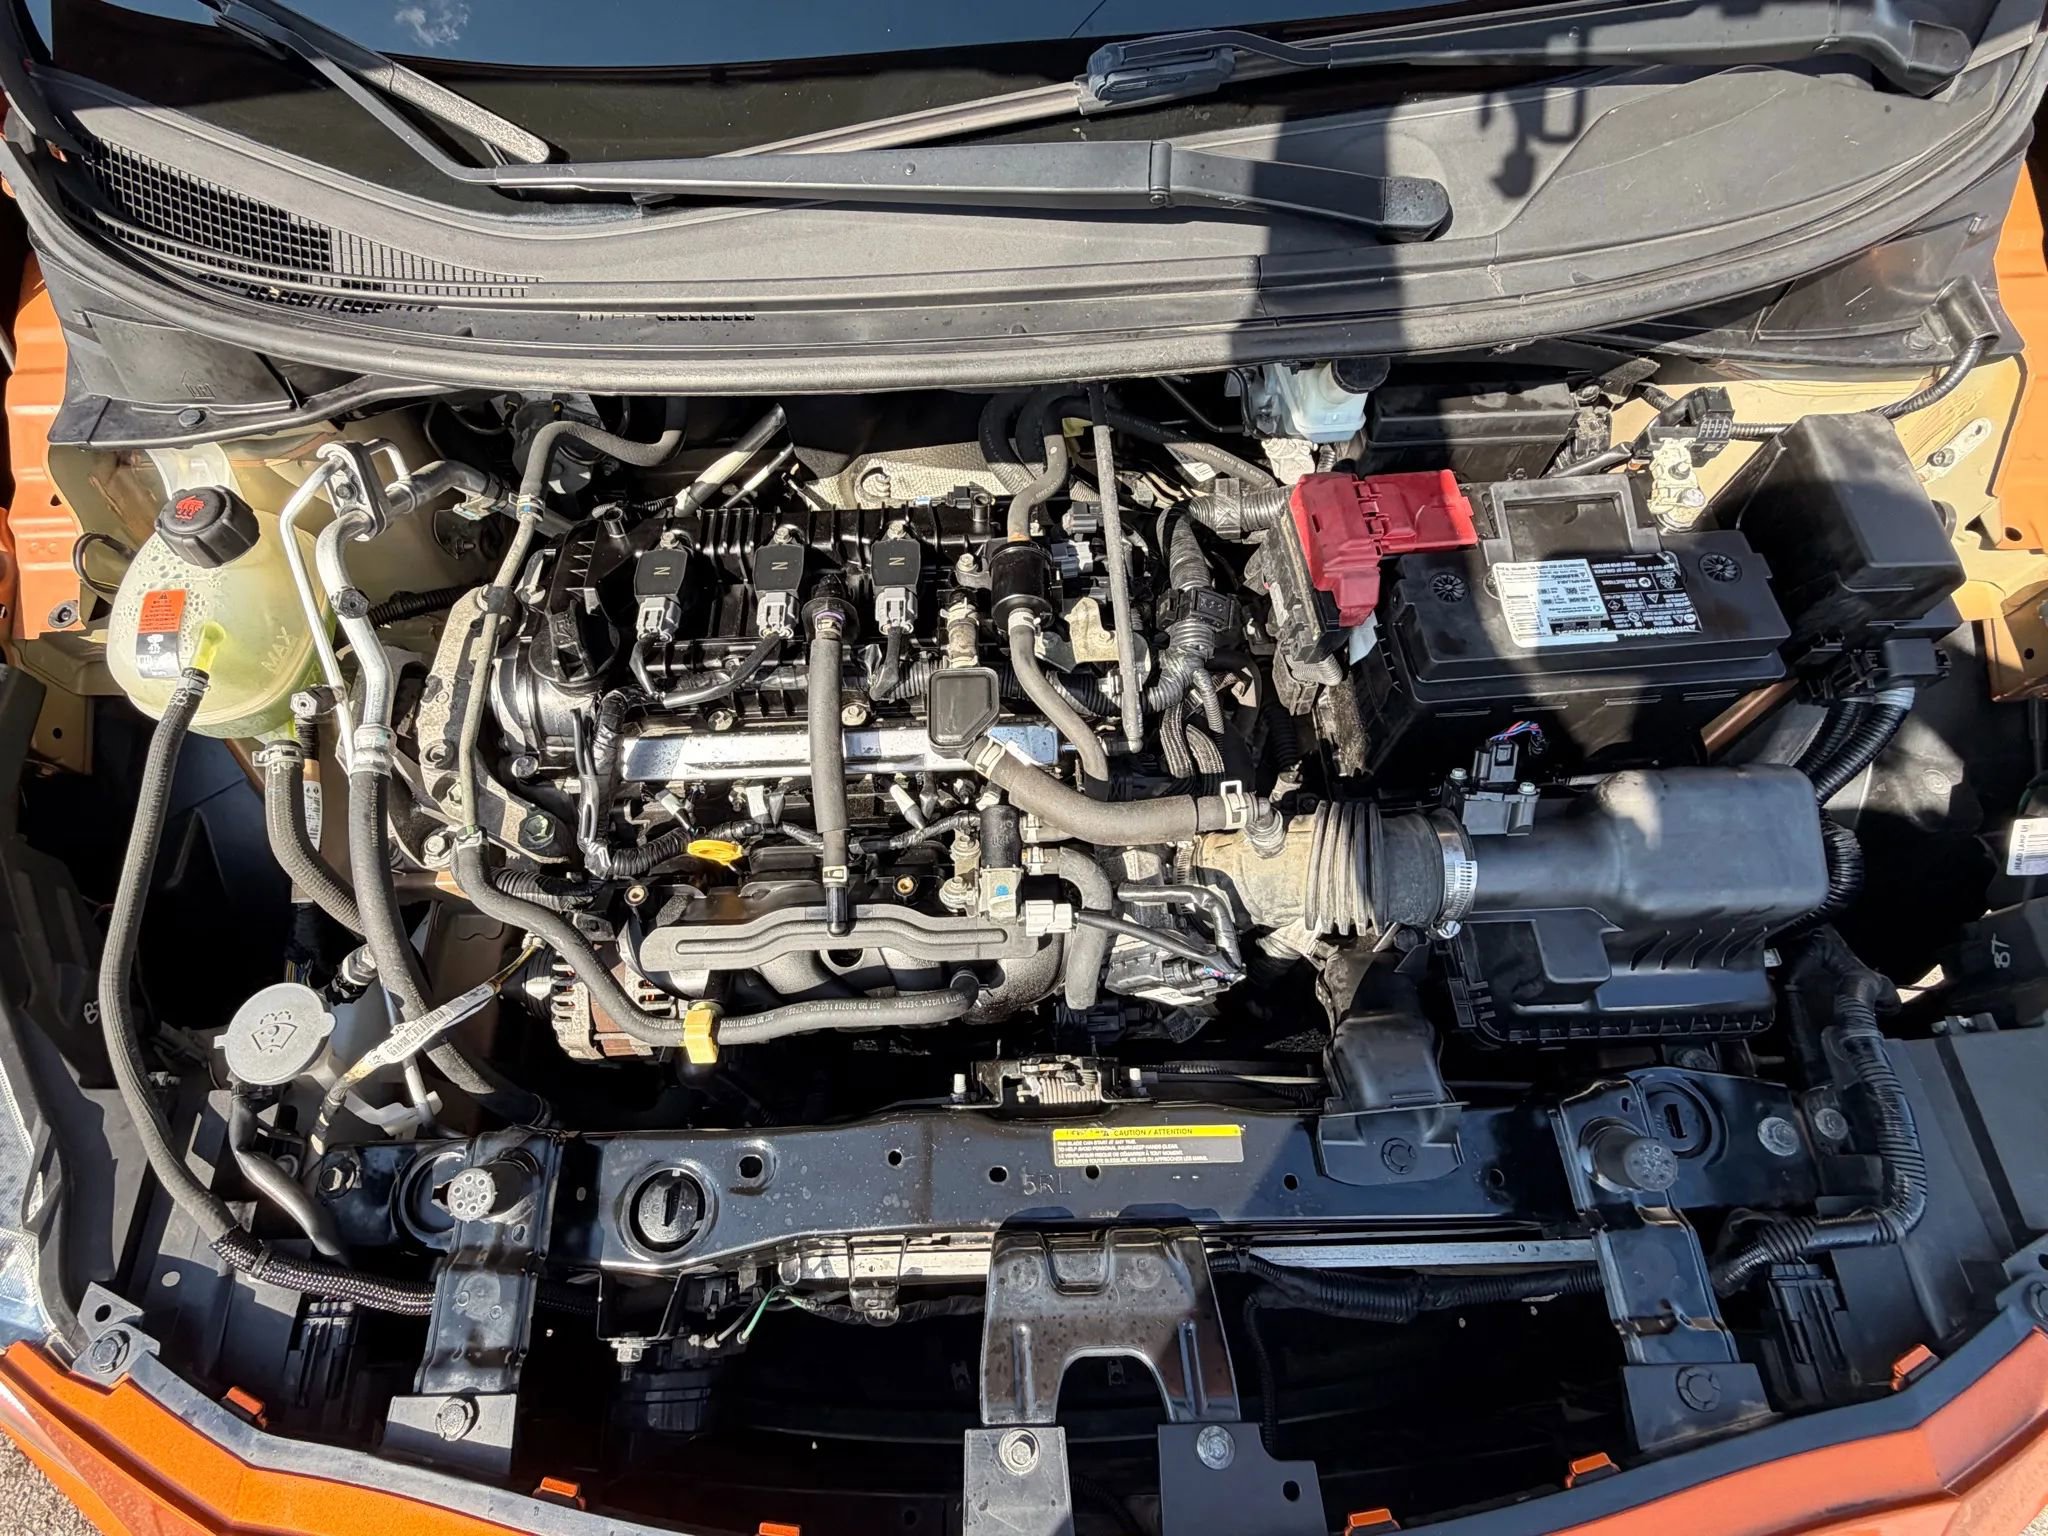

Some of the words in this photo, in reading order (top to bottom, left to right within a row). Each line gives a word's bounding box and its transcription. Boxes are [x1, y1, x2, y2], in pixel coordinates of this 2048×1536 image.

[261, 626, 290, 673] MAX
[2016, 834, 2026, 851] LAMP
[2014, 852, 2023, 870] HEAD
[1991, 932, 2011, 968] BT
[1114, 1129, 1146, 1137] CAUTION
